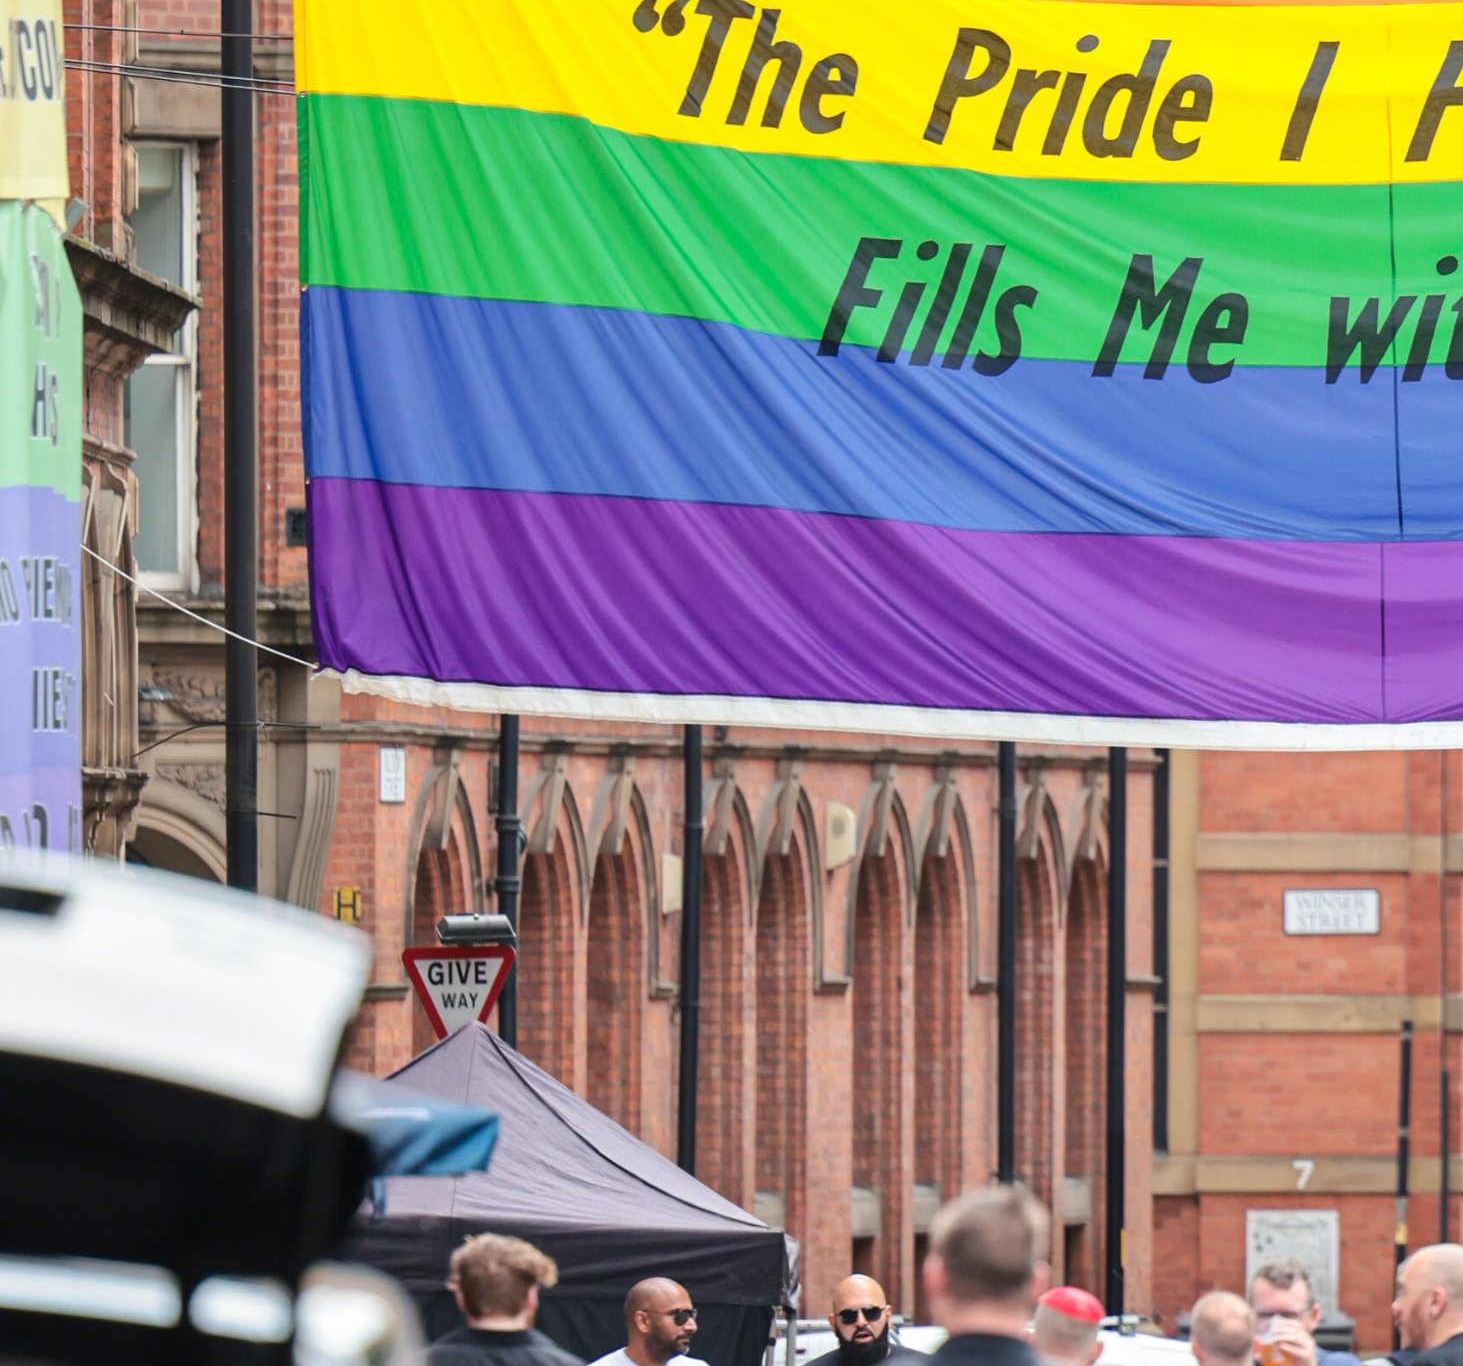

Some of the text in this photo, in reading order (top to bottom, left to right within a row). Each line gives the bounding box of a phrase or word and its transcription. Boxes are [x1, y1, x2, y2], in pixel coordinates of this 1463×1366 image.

[922, 27, 1214, 161] Pride
[1279, 41, 1340, 161] I
[816, 236, 1039, 376] Fills
[1090, 253, 1249, 383] Me
[1296, 913, 1365, 928] STREET
[427, 961, 487, 985] GIVE
[441, 993, 479, 1009] WAY
[1292, 1159, 1315, 1190] 7
